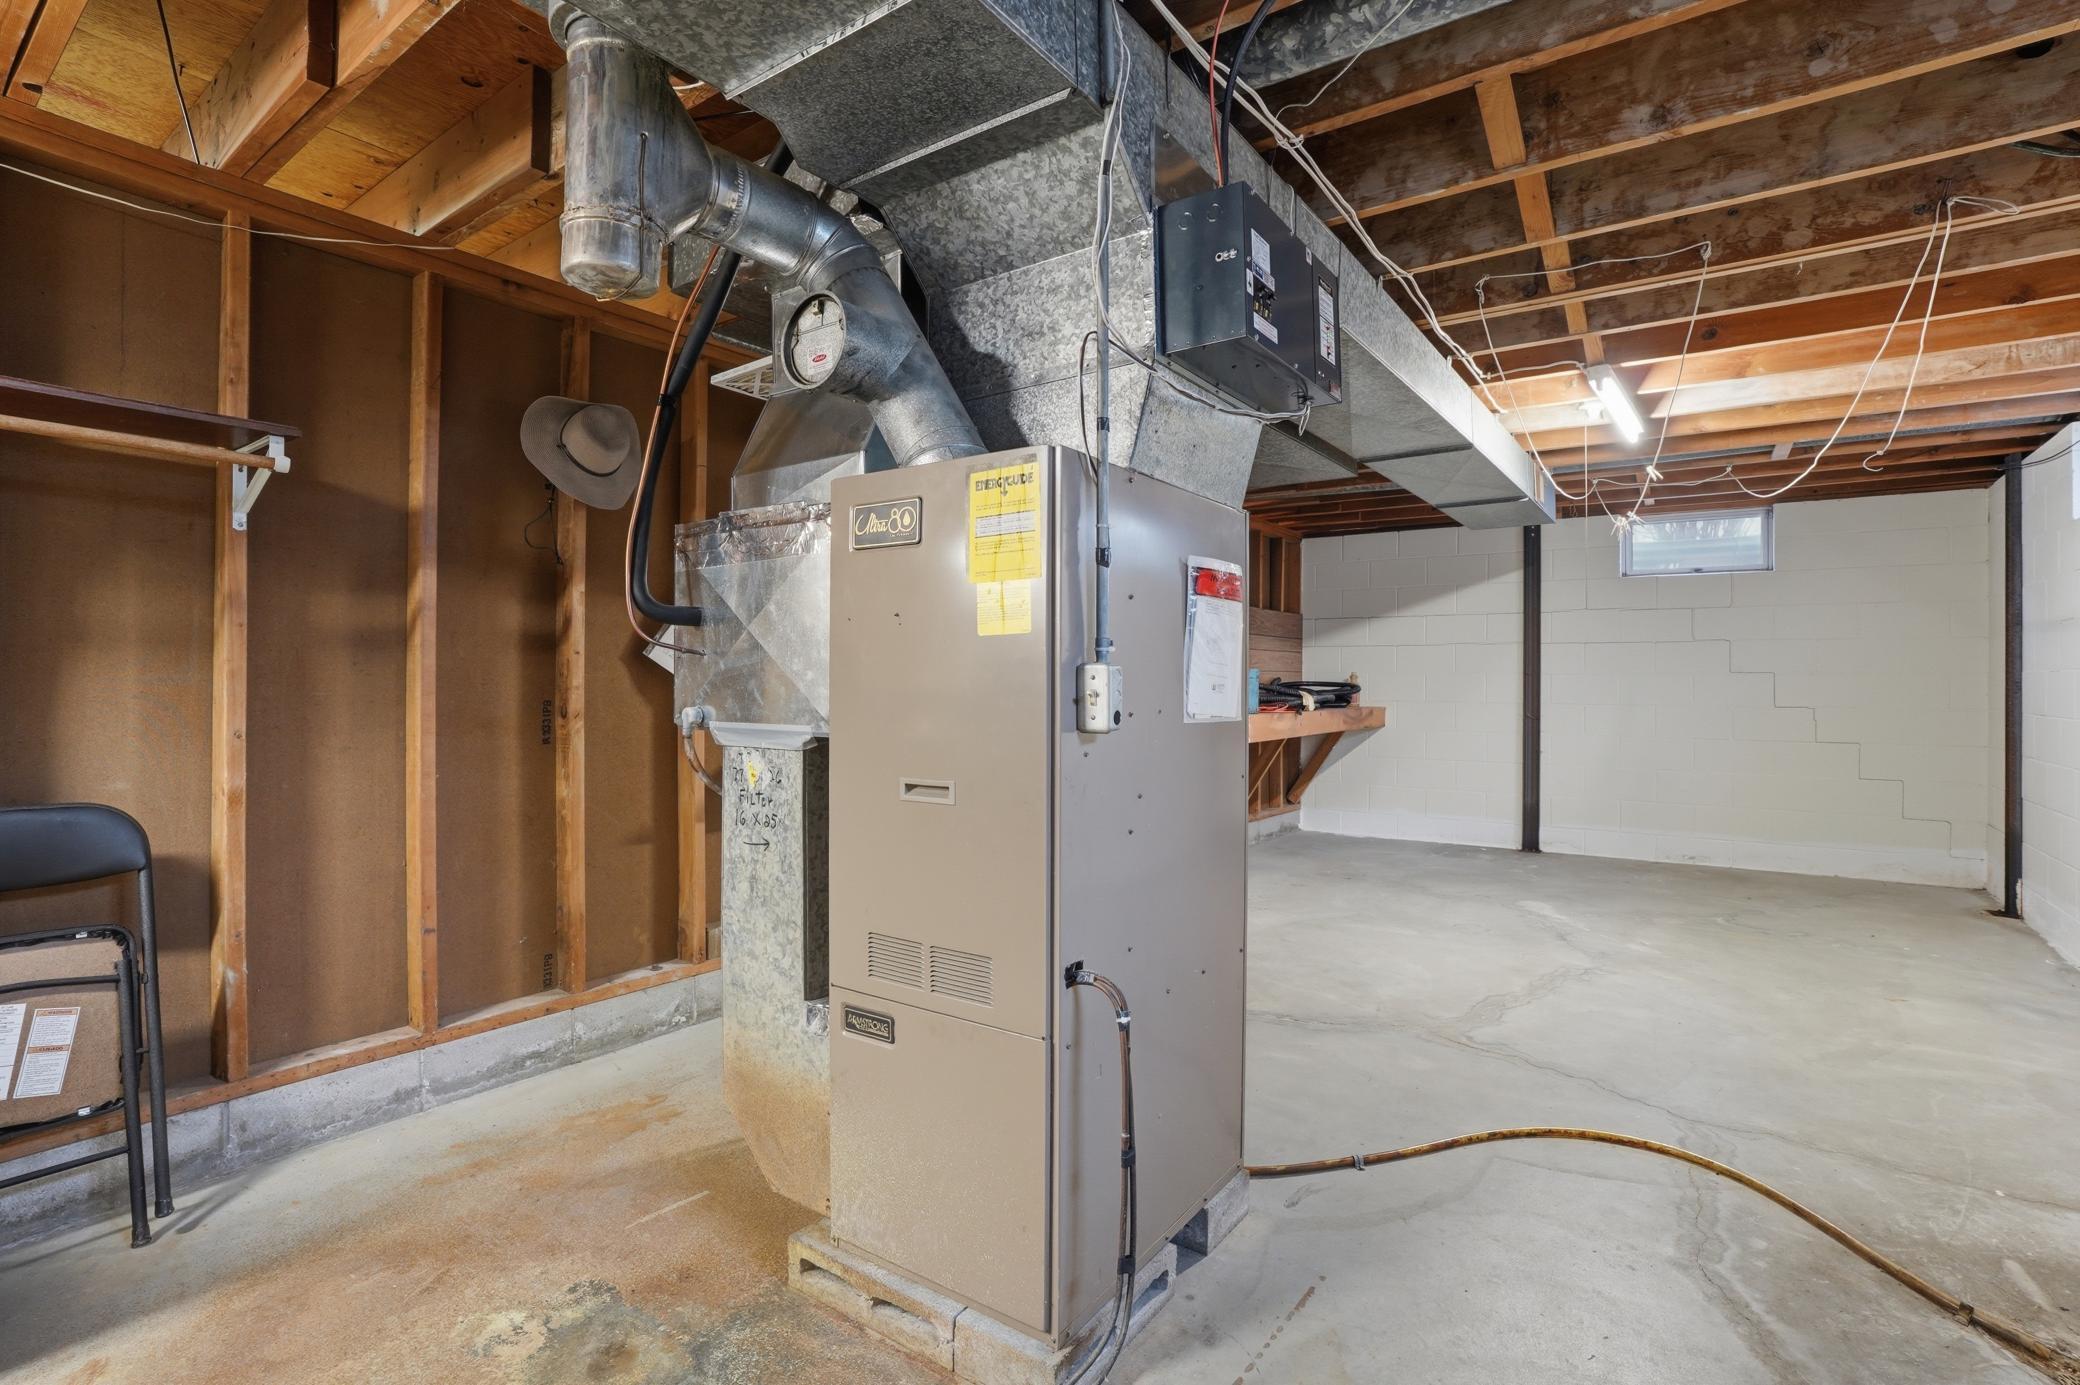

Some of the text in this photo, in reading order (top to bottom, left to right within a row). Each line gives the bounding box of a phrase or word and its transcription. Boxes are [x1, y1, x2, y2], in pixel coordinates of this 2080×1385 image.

[855, 506, 917, 535] Ultra 80
[735, 808, 746, 826] 16
[847, 1013, 889, 1033] ARMSTRONG
